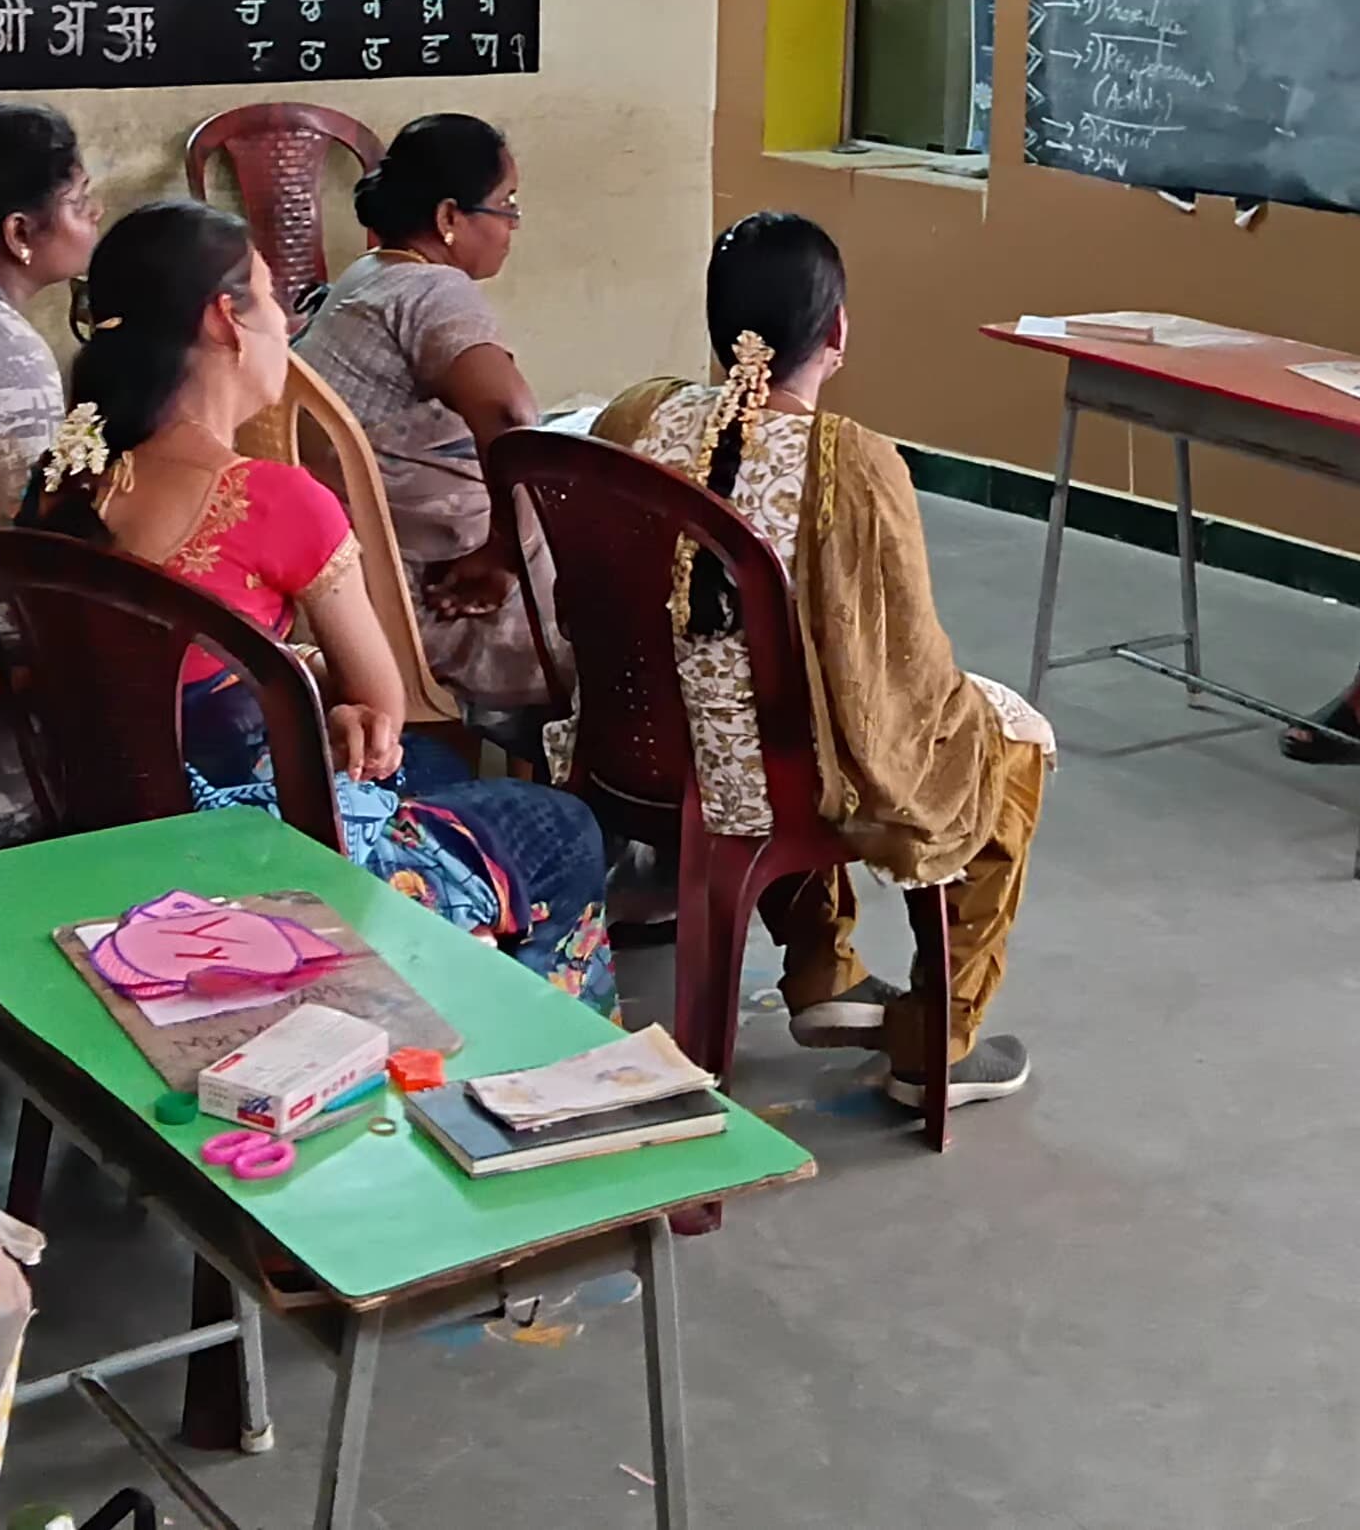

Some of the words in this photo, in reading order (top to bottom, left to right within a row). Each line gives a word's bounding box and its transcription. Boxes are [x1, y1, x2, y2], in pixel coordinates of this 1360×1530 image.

[234, 0, 267, 25] च
[102, 5, 157, 63] अः
[300, 40, 326, 71] ठ
[361, 37, 390, 71] ड
